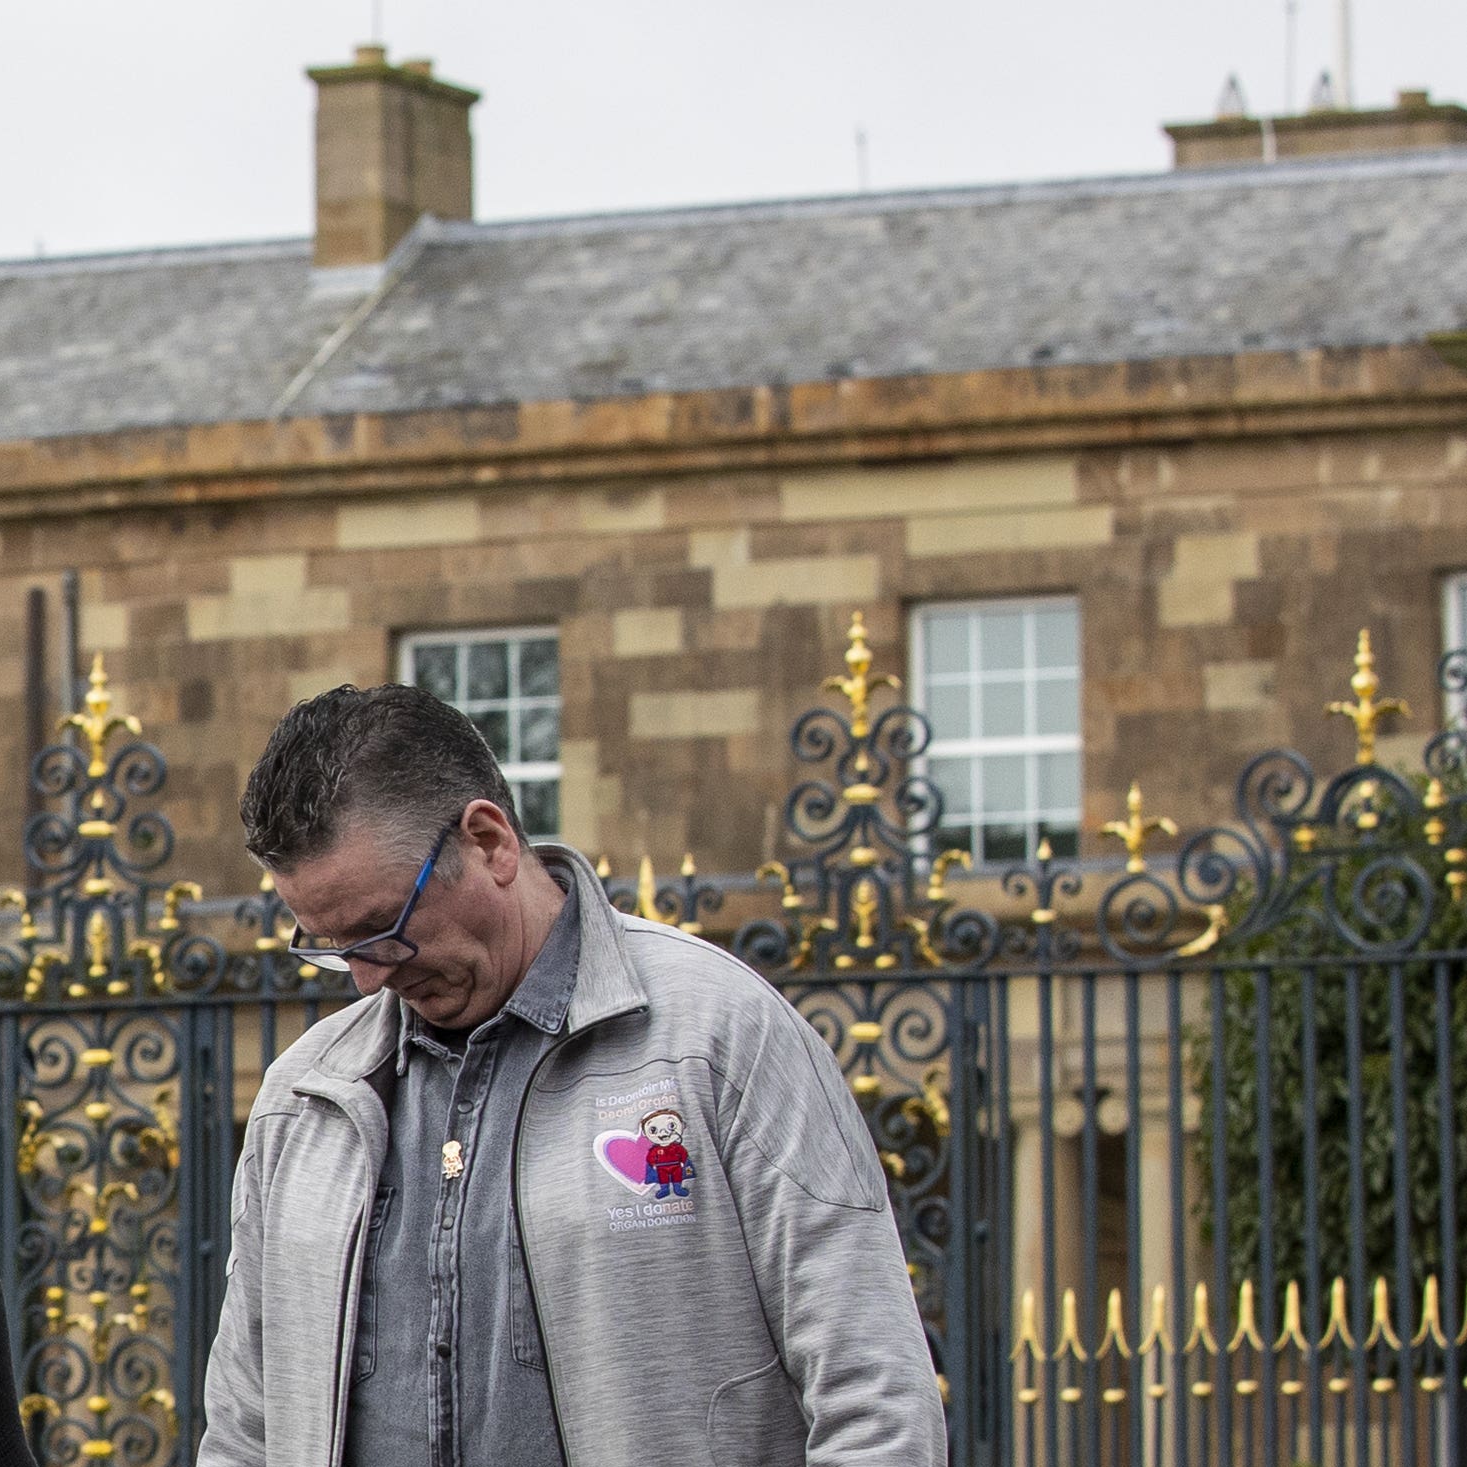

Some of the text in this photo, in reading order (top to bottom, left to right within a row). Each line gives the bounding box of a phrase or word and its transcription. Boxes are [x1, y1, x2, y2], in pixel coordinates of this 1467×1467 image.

[595, 1097, 607, 1107] Is
[643, 1199, 695, 1216] donate
[609, 1214, 696, 1231] ORGAN DONATION
